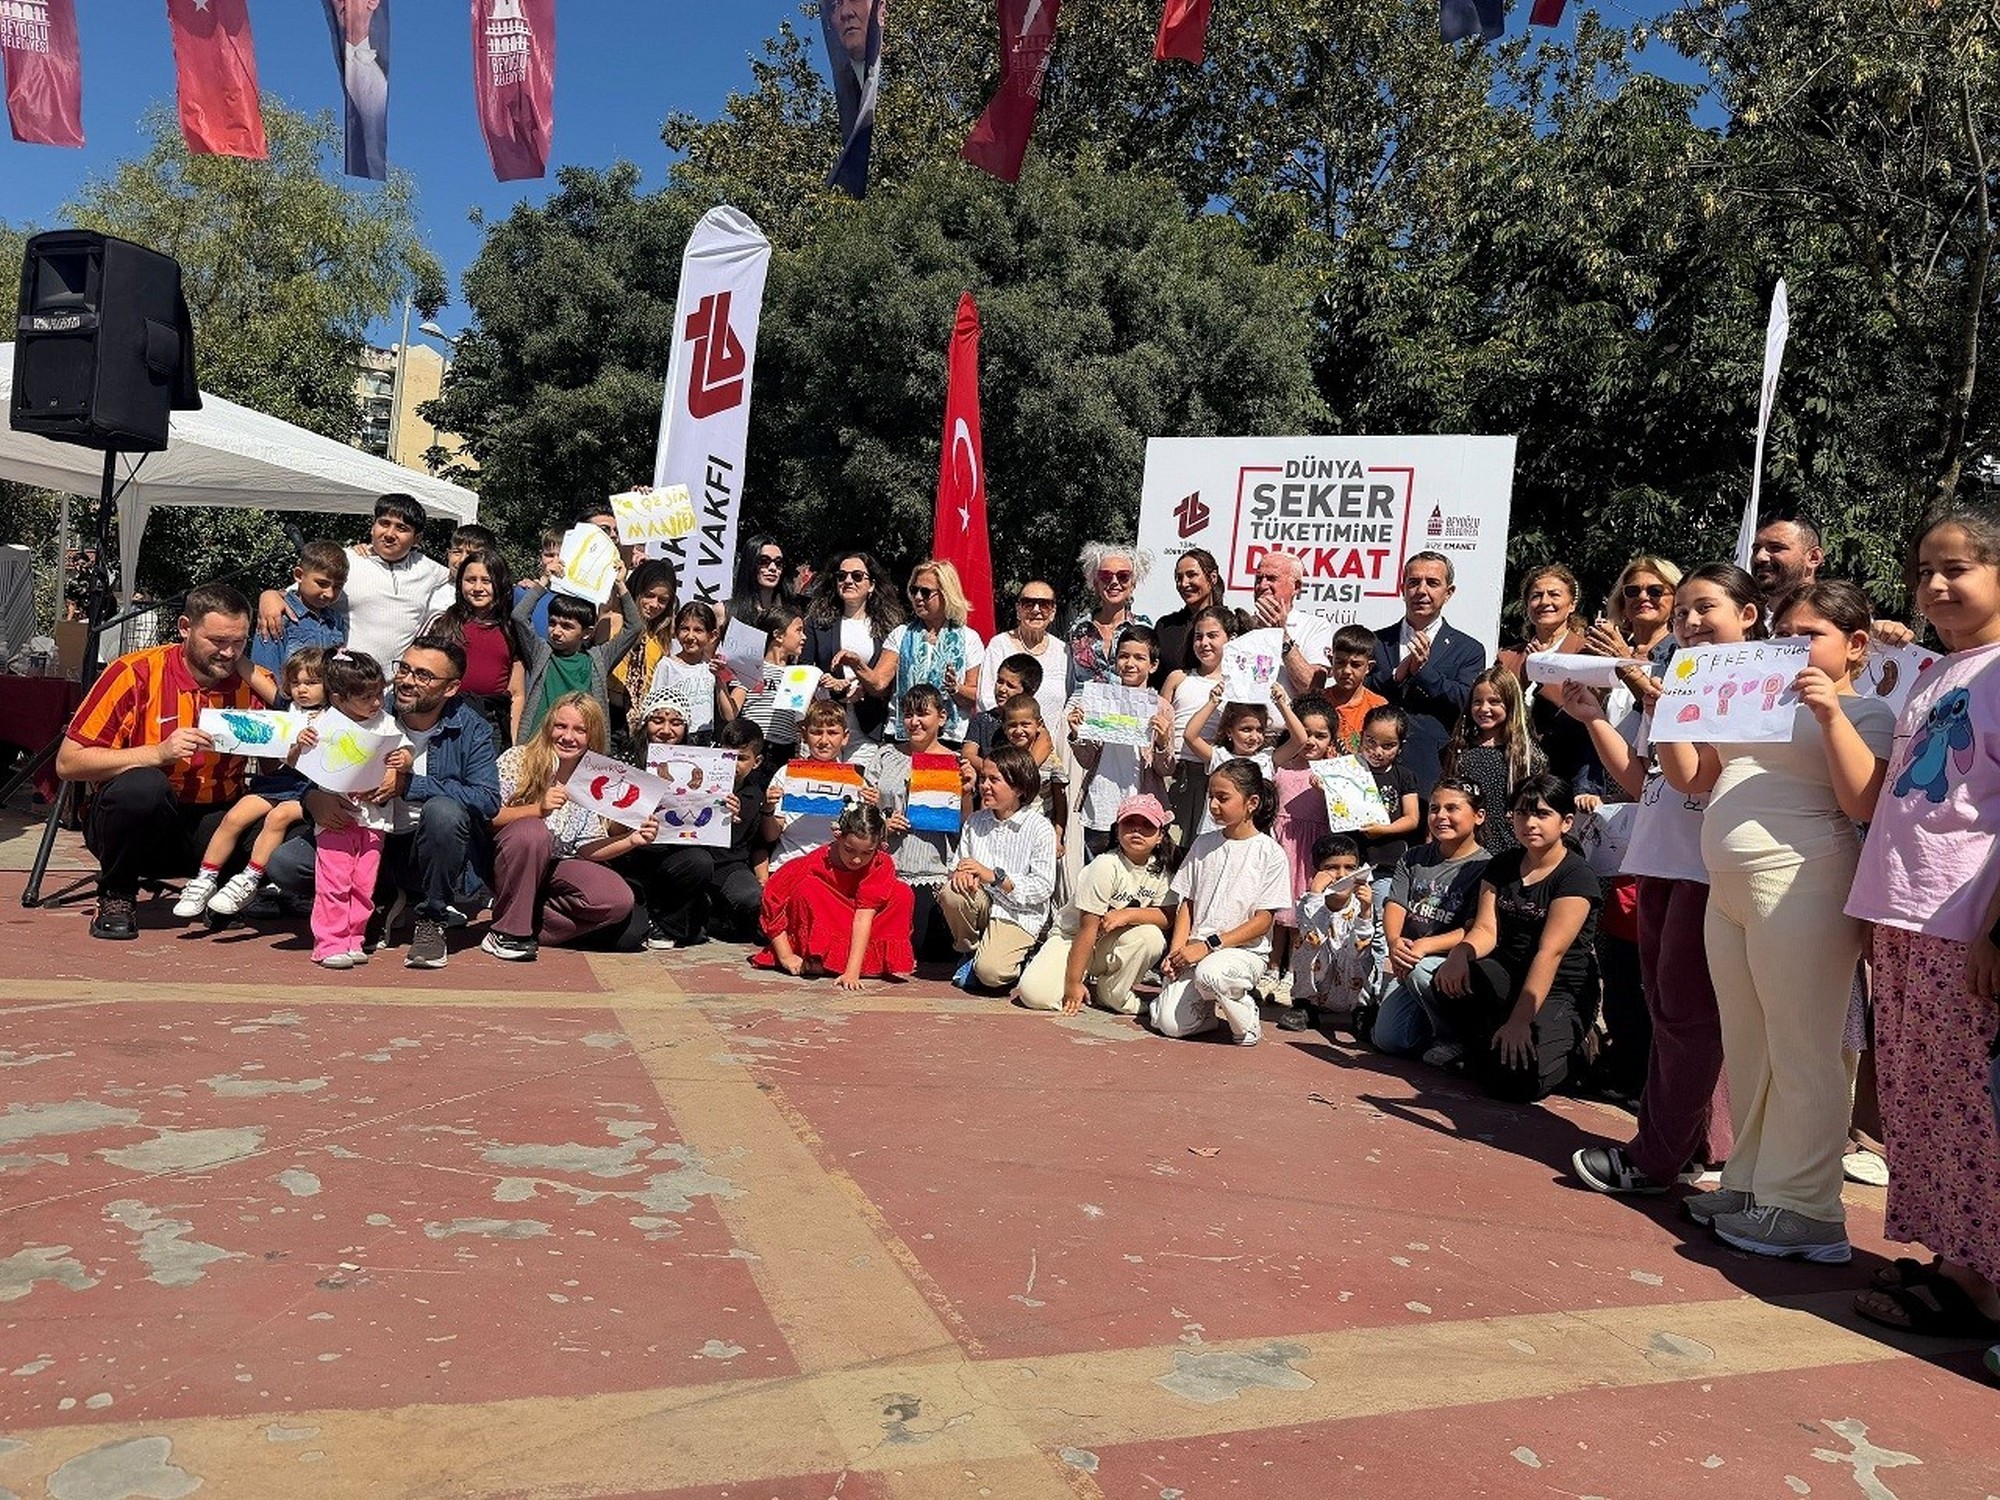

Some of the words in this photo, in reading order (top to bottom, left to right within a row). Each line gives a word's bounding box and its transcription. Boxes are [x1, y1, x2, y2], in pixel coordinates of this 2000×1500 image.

[1286, 455, 1364, 479] DÜNYA
[698, 454, 733, 566] VAKFI
[1250, 484, 1396, 520] ŞEKER
